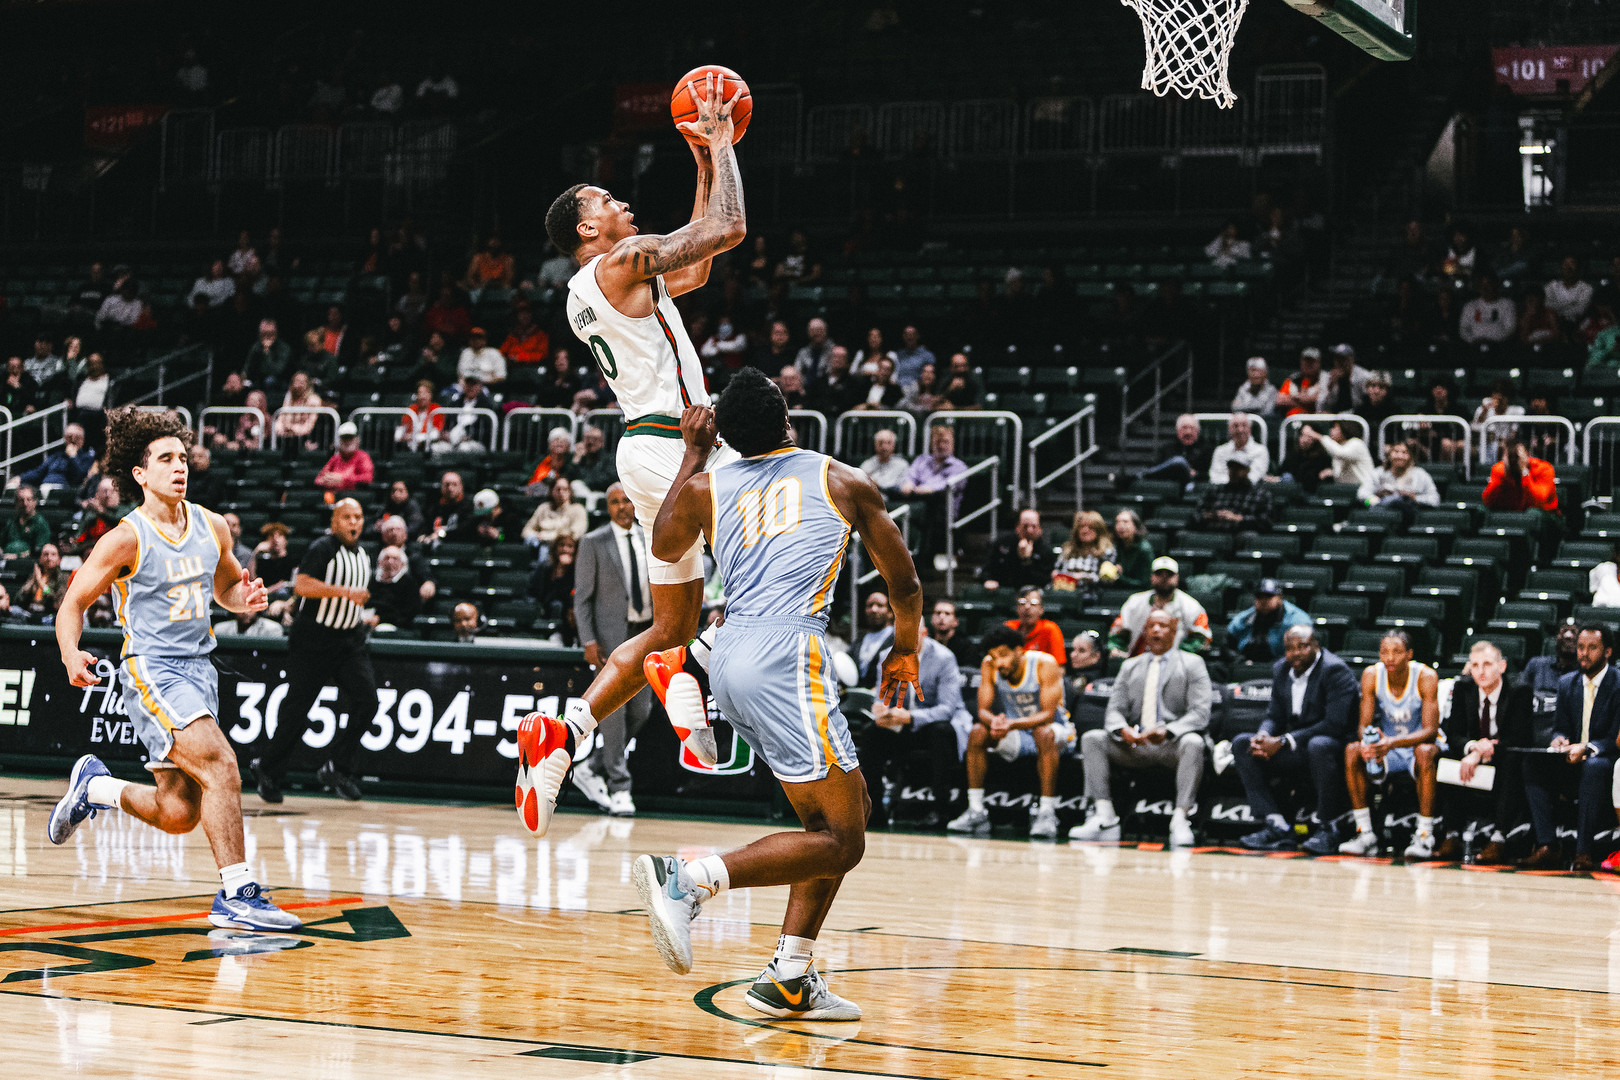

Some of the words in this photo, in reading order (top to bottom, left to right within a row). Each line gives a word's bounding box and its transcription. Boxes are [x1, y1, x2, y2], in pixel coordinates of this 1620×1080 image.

[1511, 59, 1546, 80] 101
[588, 335, 618, 380] 0
[736, 476, 802, 549] 10
[165, 555, 204, 582] LIU
[168, 582, 205, 621] 21
[1211, 803, 1256, 822] KI
